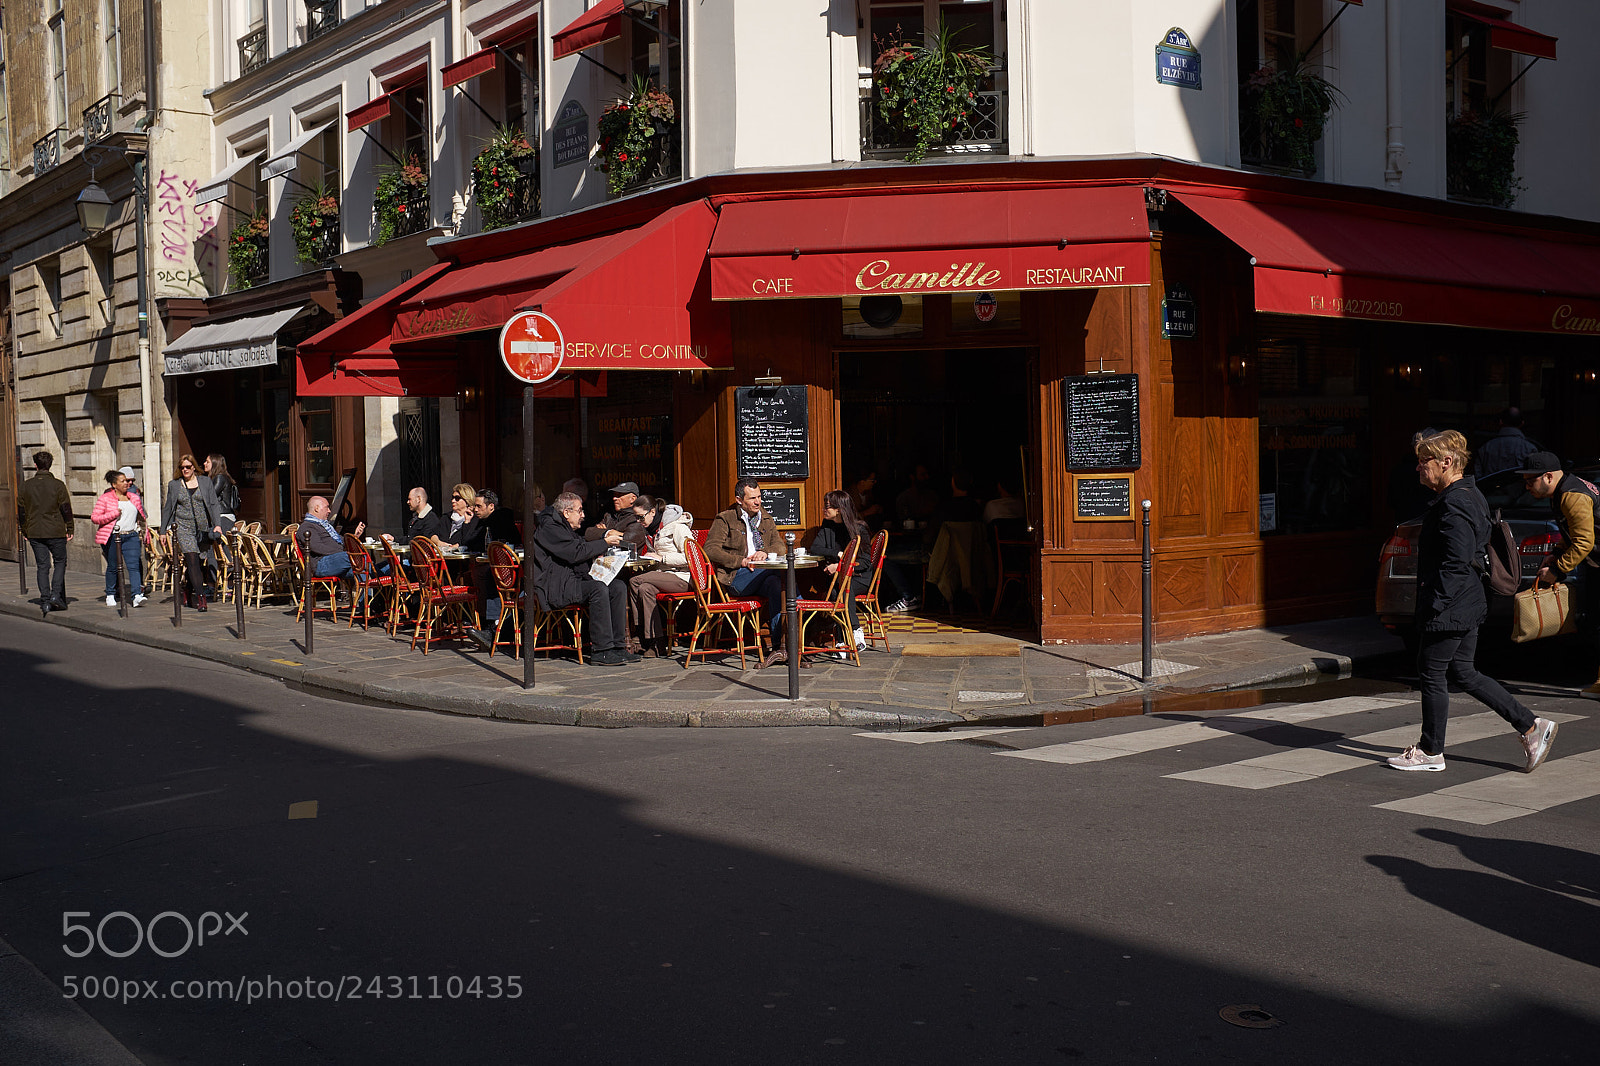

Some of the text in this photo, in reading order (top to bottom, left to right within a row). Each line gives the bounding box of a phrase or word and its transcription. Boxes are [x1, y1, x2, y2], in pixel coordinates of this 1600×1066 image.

[1170, 56, 1188, 68] RUE
[1162, 67, 1196, 82] ELZÉVIR
[565, 126, 577, 137] RUE
[555, 135, 588, 151] DES FRANCS
[557, 145, 587, 161] BOURGEOIS
[752, 259, 1126, 294] CAFE Camille RESTAURANT
[981, 305, 990, 314] IV
[1172, 310, 1186, 319] RUE
[409, 307, 476, 337] Camille
[566, 342, 708, 360] SERVICE CONTINU
[598, 416, 653, 433] BREAKFAST
[592, 445, 623, 459] SALON
[627, 446, 638, 458] de
[594, 471, 657, 488] CAPPUCCINO
